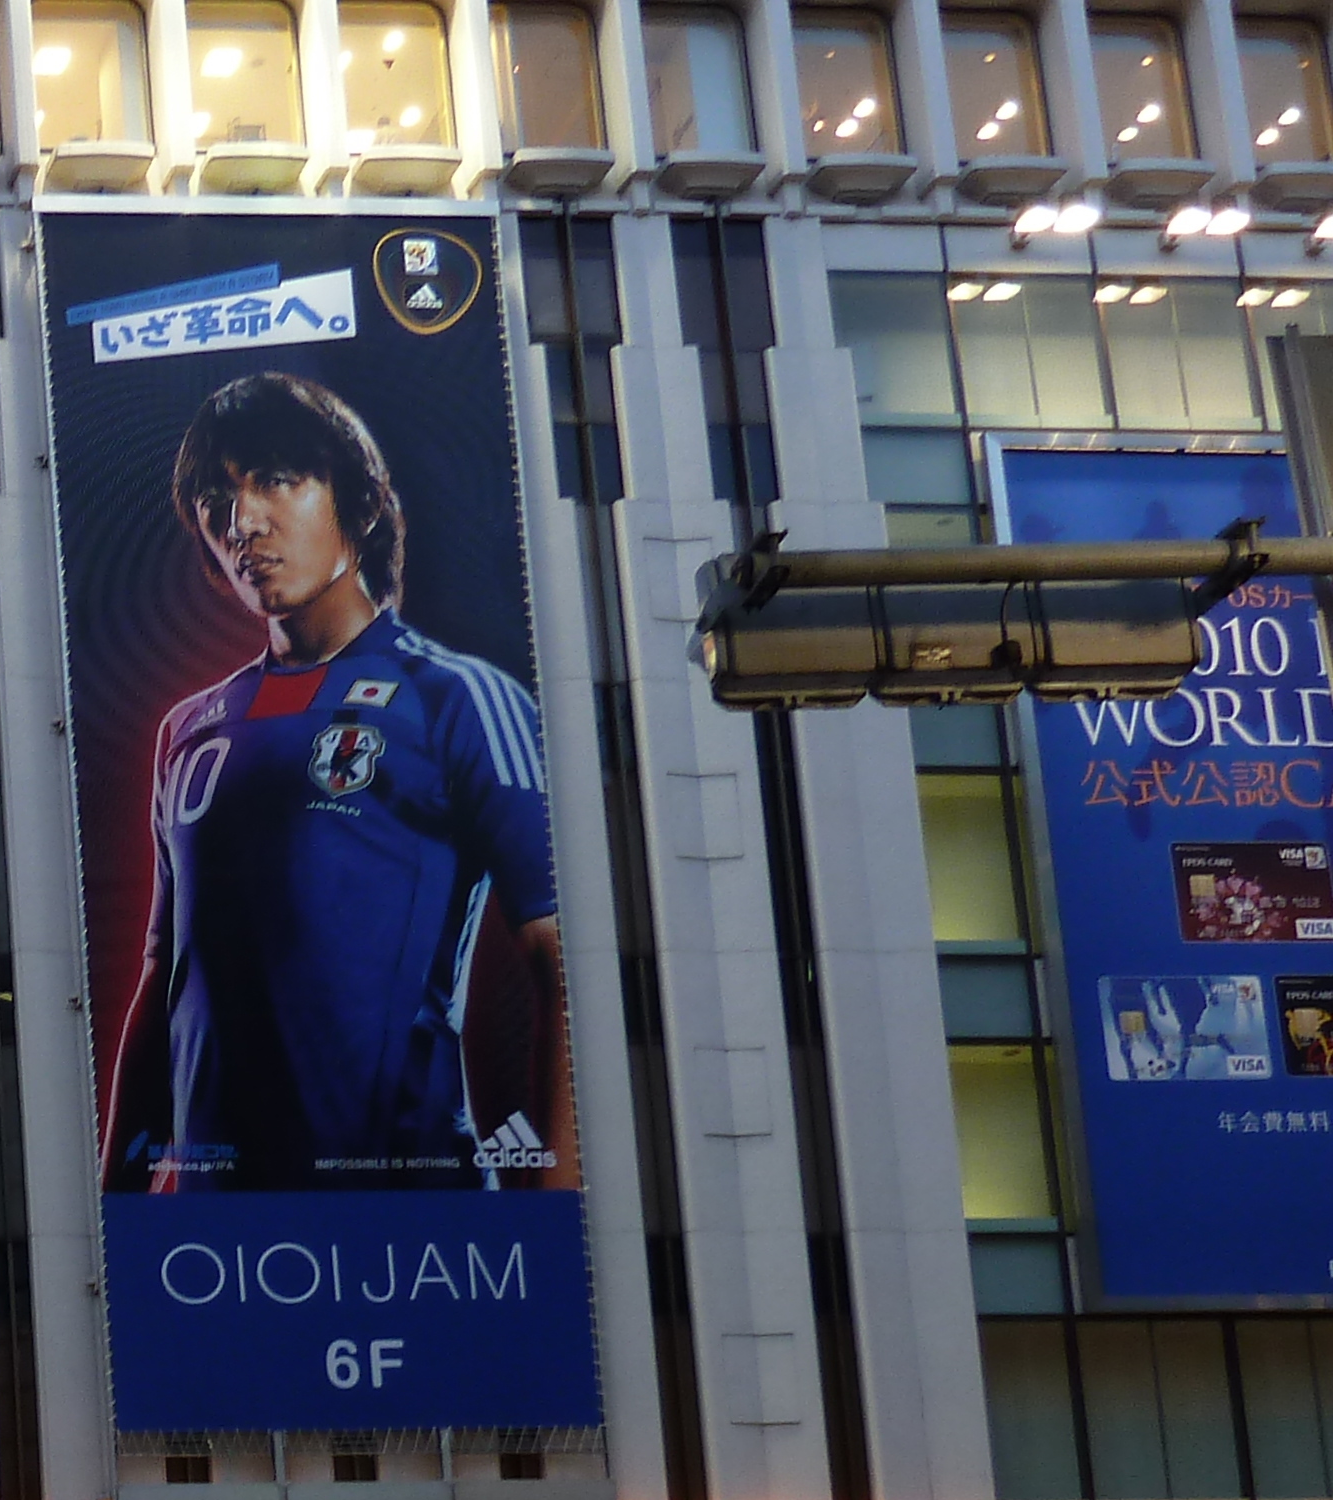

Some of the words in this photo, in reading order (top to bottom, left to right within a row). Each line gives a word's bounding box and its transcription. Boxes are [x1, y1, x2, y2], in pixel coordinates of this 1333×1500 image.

[101, 295, 350, 354] いざ革命へ。
[1191, 616, 1290, 677] 010
[305, 800, 361, 817] JAPAN
[1081, 759, 1333, 809] 公式公認C
[1232, 1059, 1265, 1071] VISA
[473, 1147, 558, 1168] adidas
[325, 1339, 403, 1390] 6F
